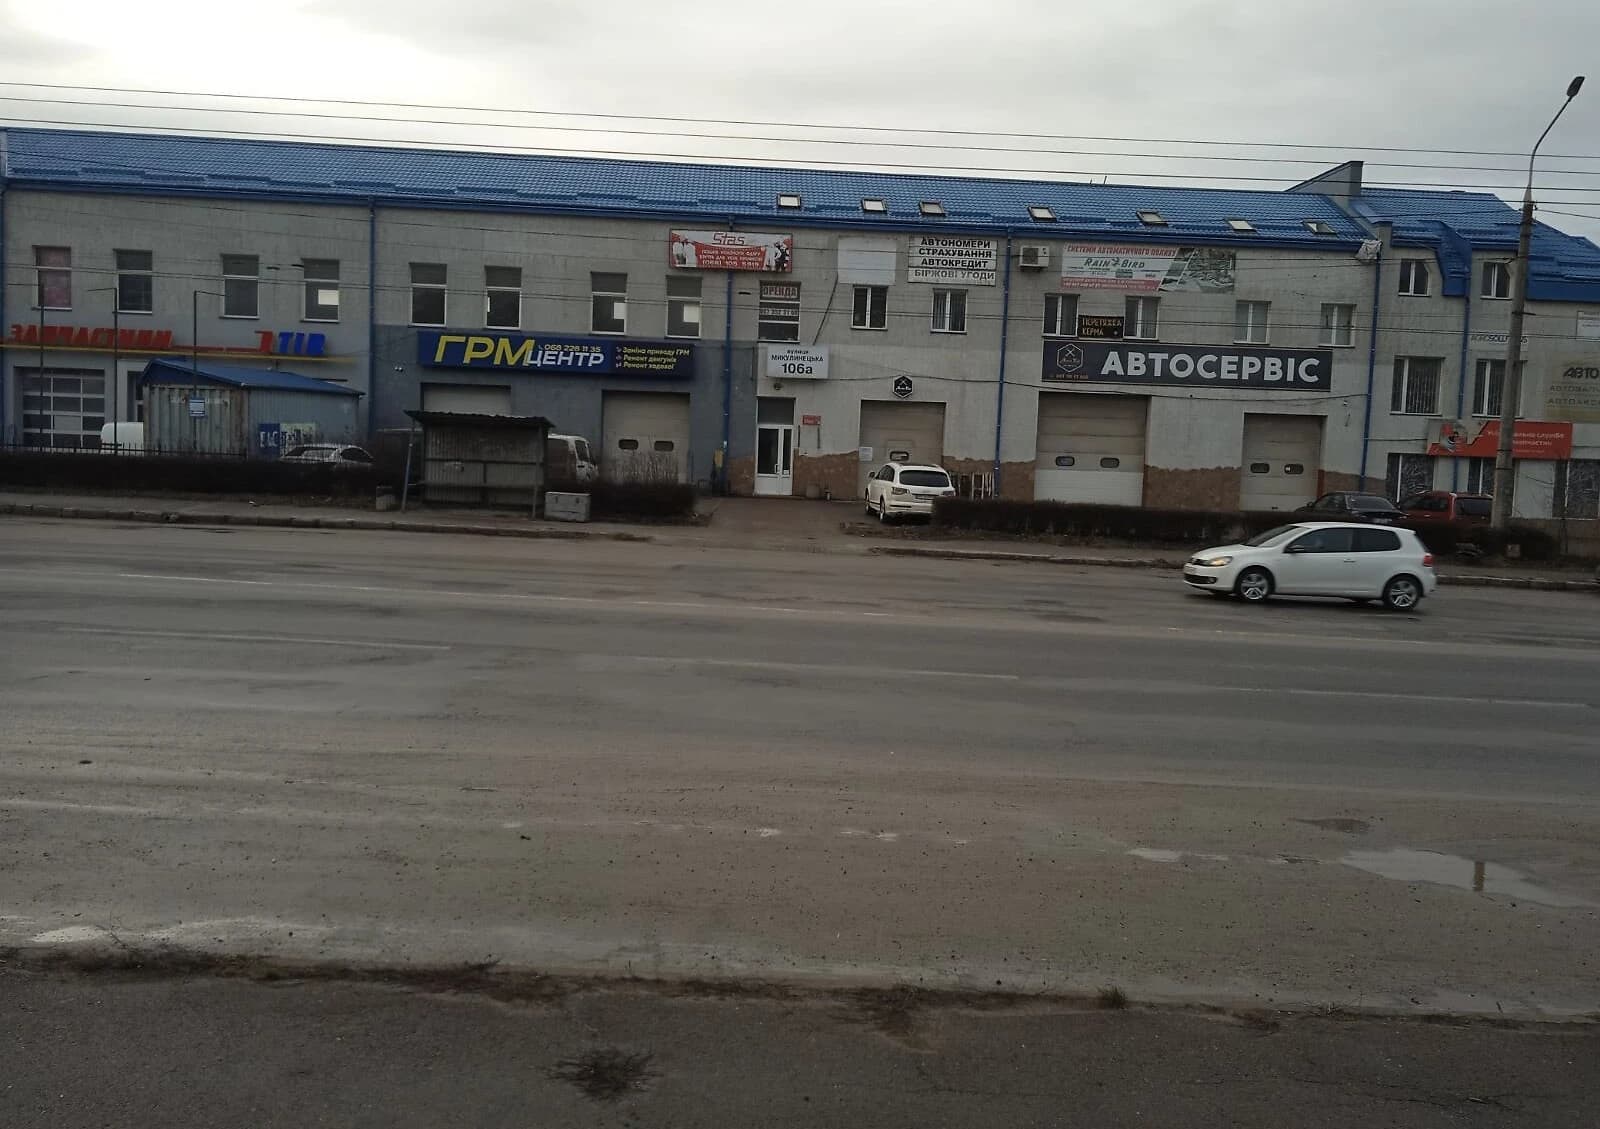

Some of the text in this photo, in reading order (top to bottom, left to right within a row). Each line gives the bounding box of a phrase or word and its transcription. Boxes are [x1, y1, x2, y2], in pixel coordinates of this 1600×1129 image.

[920, 238, 991, 248] АВТОНОМЕРИ
[919, 248, 992, 258] СТРАХУВАННЯ
[921, 258, 989, 268] АВТОКРЕДИТ
[914, 269, 995, 280] БІРЖОВІ УГОДИ
[1082, 328, 1104, 336] КЕРМА
[434, 335, 605, 367] ГРМ ЦЕНТР
[624, 354, 647, 362] Ремонт
[771, 354, 824, 362] МИКУЛИНЕЦЬКА
[624, 361, 647, 369] Ремонт
[1100, 350, 1321, 383] АВТОСЕРВІС
